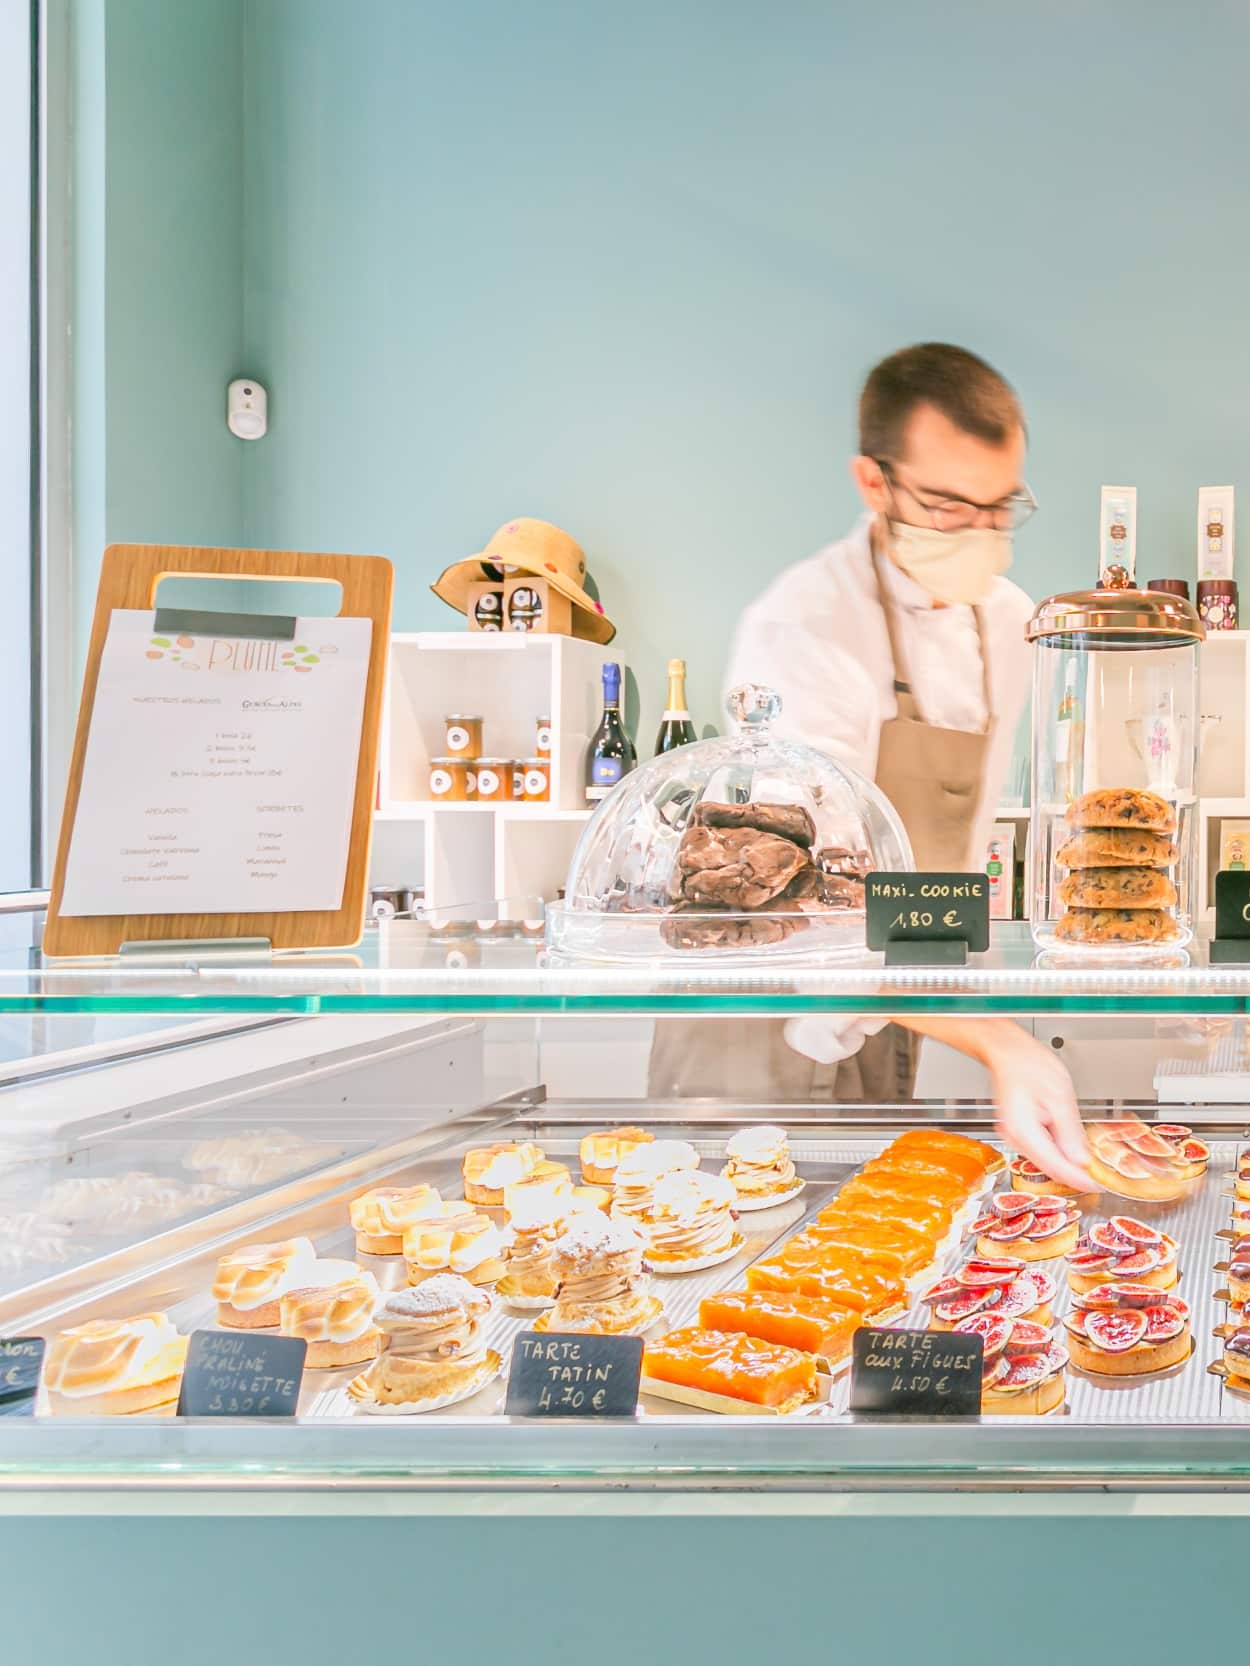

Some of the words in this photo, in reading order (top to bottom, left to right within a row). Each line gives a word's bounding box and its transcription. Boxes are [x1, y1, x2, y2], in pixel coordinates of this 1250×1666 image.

[943, 910, 962, 927] €
[869, 1332, 938, 1349] TARTE
[521, 1340, 581, 1361] TARTE
[865, 1353, 903, 1369] aux
[935, 1376, 952, 1394] €
[538, 1386, 585, 1411] 4.70
[591, 1388, 606, 1410] €
